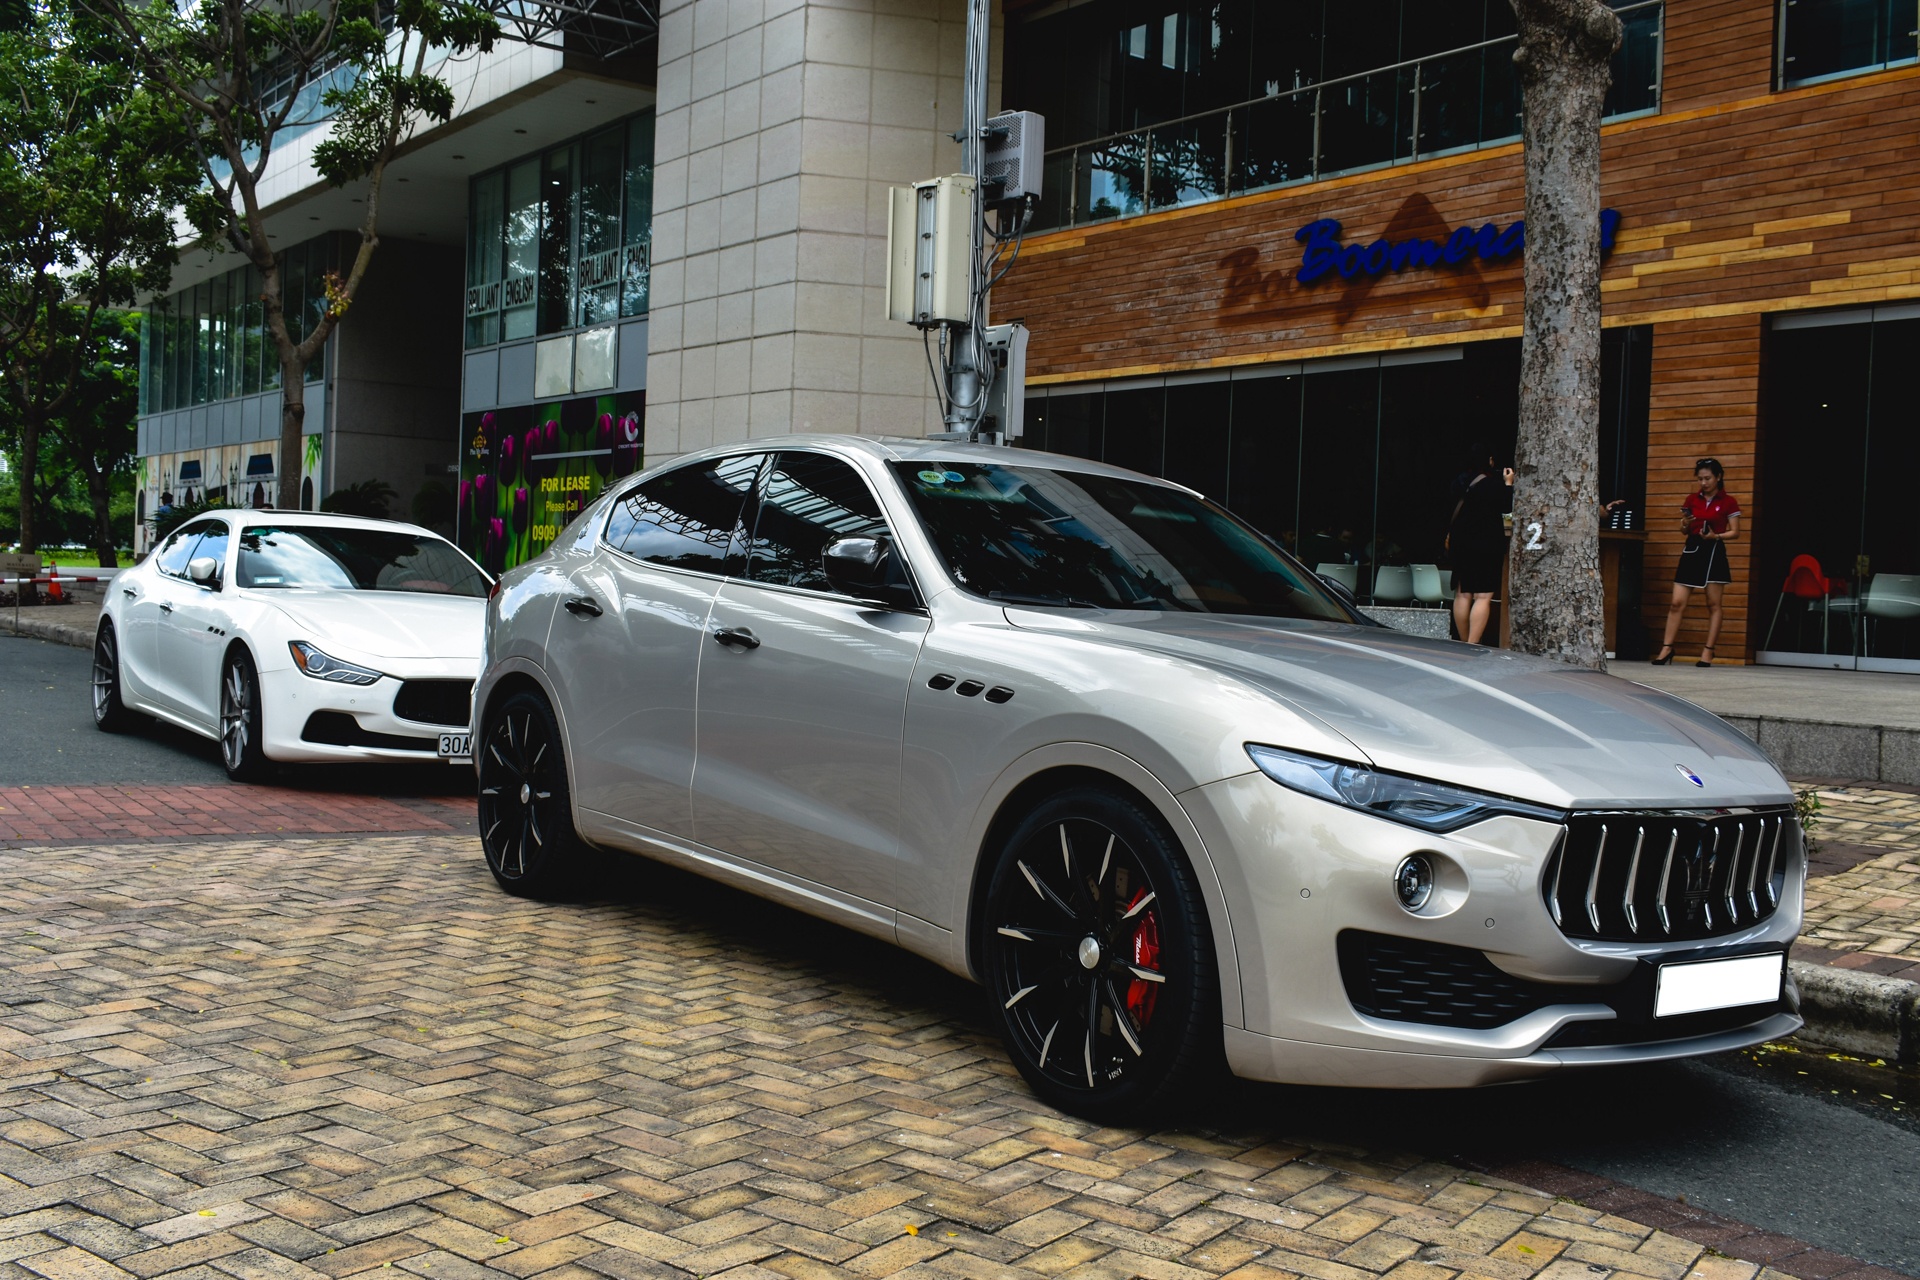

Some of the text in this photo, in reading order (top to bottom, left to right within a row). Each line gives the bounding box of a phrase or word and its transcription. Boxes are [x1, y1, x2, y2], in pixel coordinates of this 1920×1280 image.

[1294, 207, 1620, 283] Boomera
[580, 251, 618, 288] BRILLIANT
[468, 275, 534, 314] BRILLIANT ENGLISH
[541, 475, 591, 492] FOR LEASE
[545, 500, 579, 512] Please Call
[532, 524, 555, 541] 0909
[1526, 522, 1543, 550] 2
[441, 736, 471, 754] 30A
